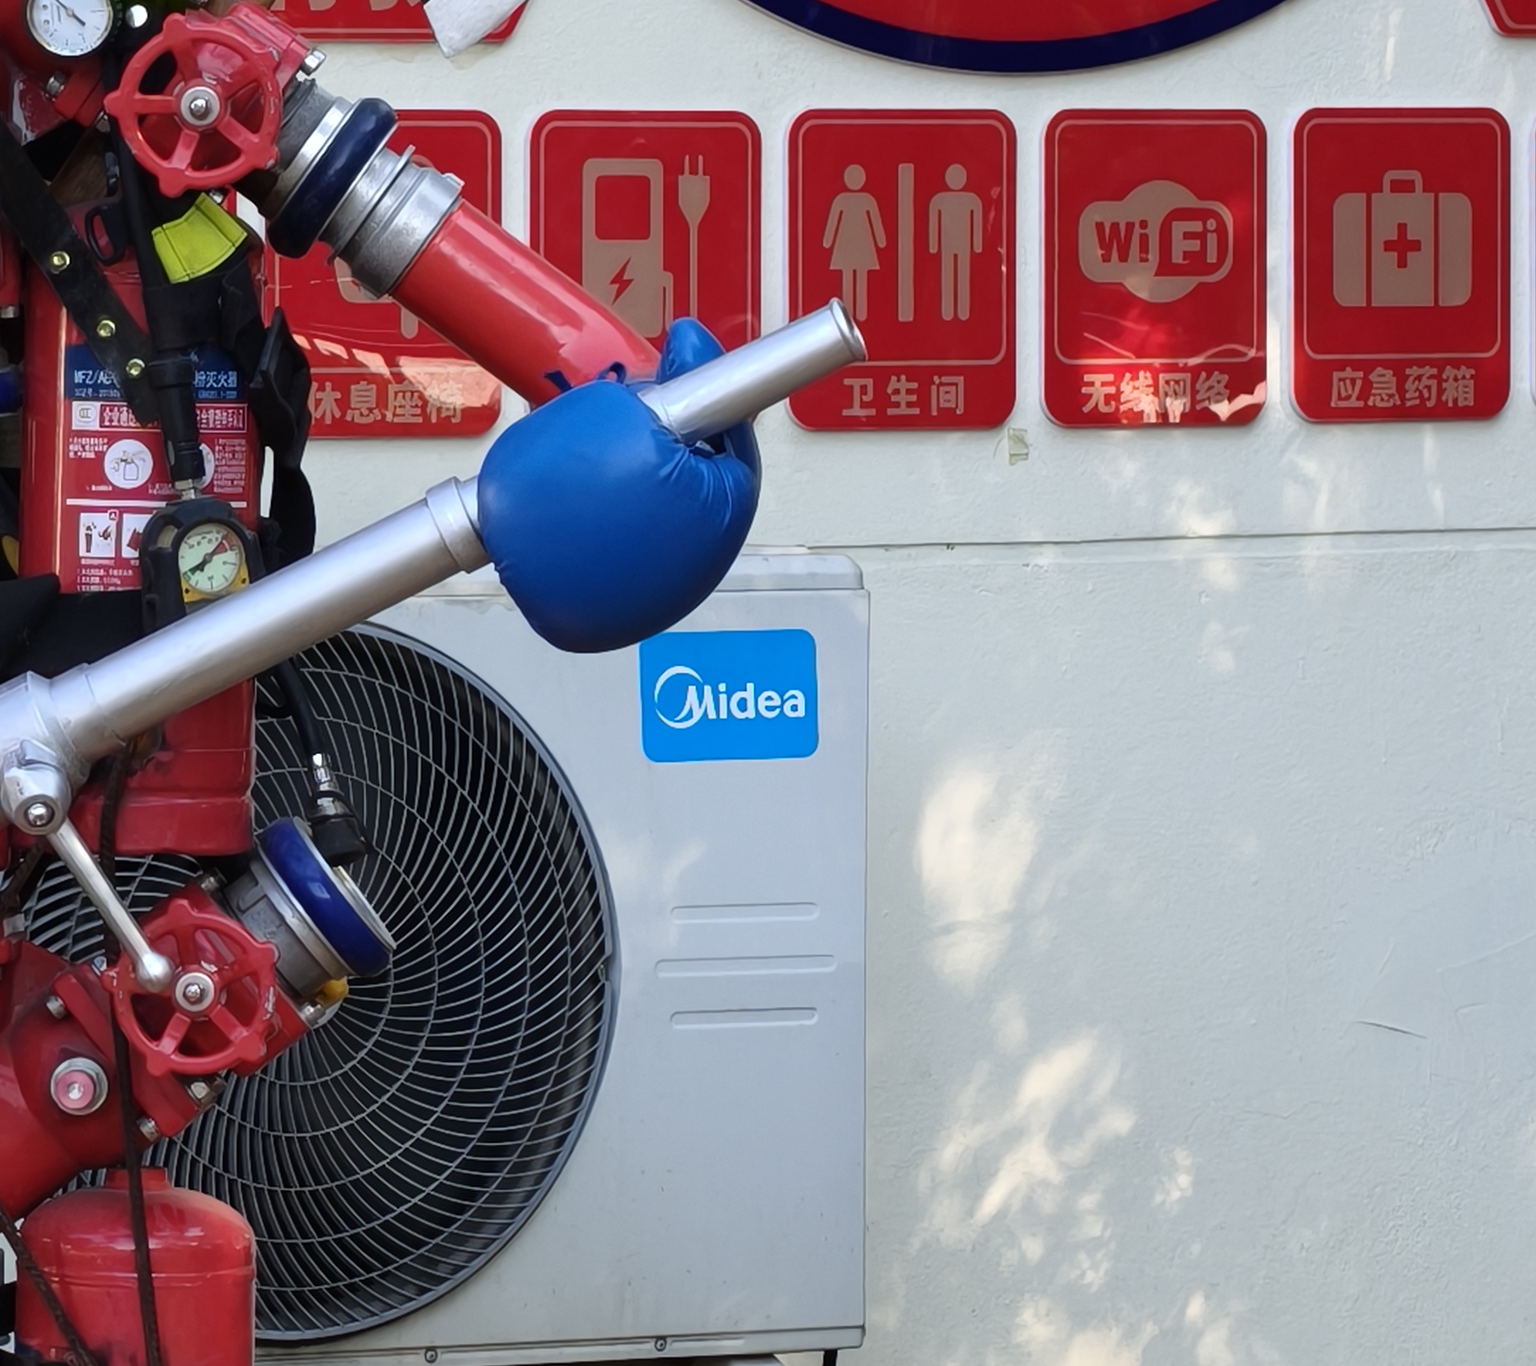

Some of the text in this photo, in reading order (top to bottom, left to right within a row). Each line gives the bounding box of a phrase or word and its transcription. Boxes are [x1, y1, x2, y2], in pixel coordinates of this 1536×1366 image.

[308, 378, 466, 426] 休息座椅
[841, 374, 966, 417] 卫生间
[1080, 370, 1230, 417] 无线网络
[1329, 365, 1477, 410] 应急药箱
[654, 666, 806, 729] Midea
